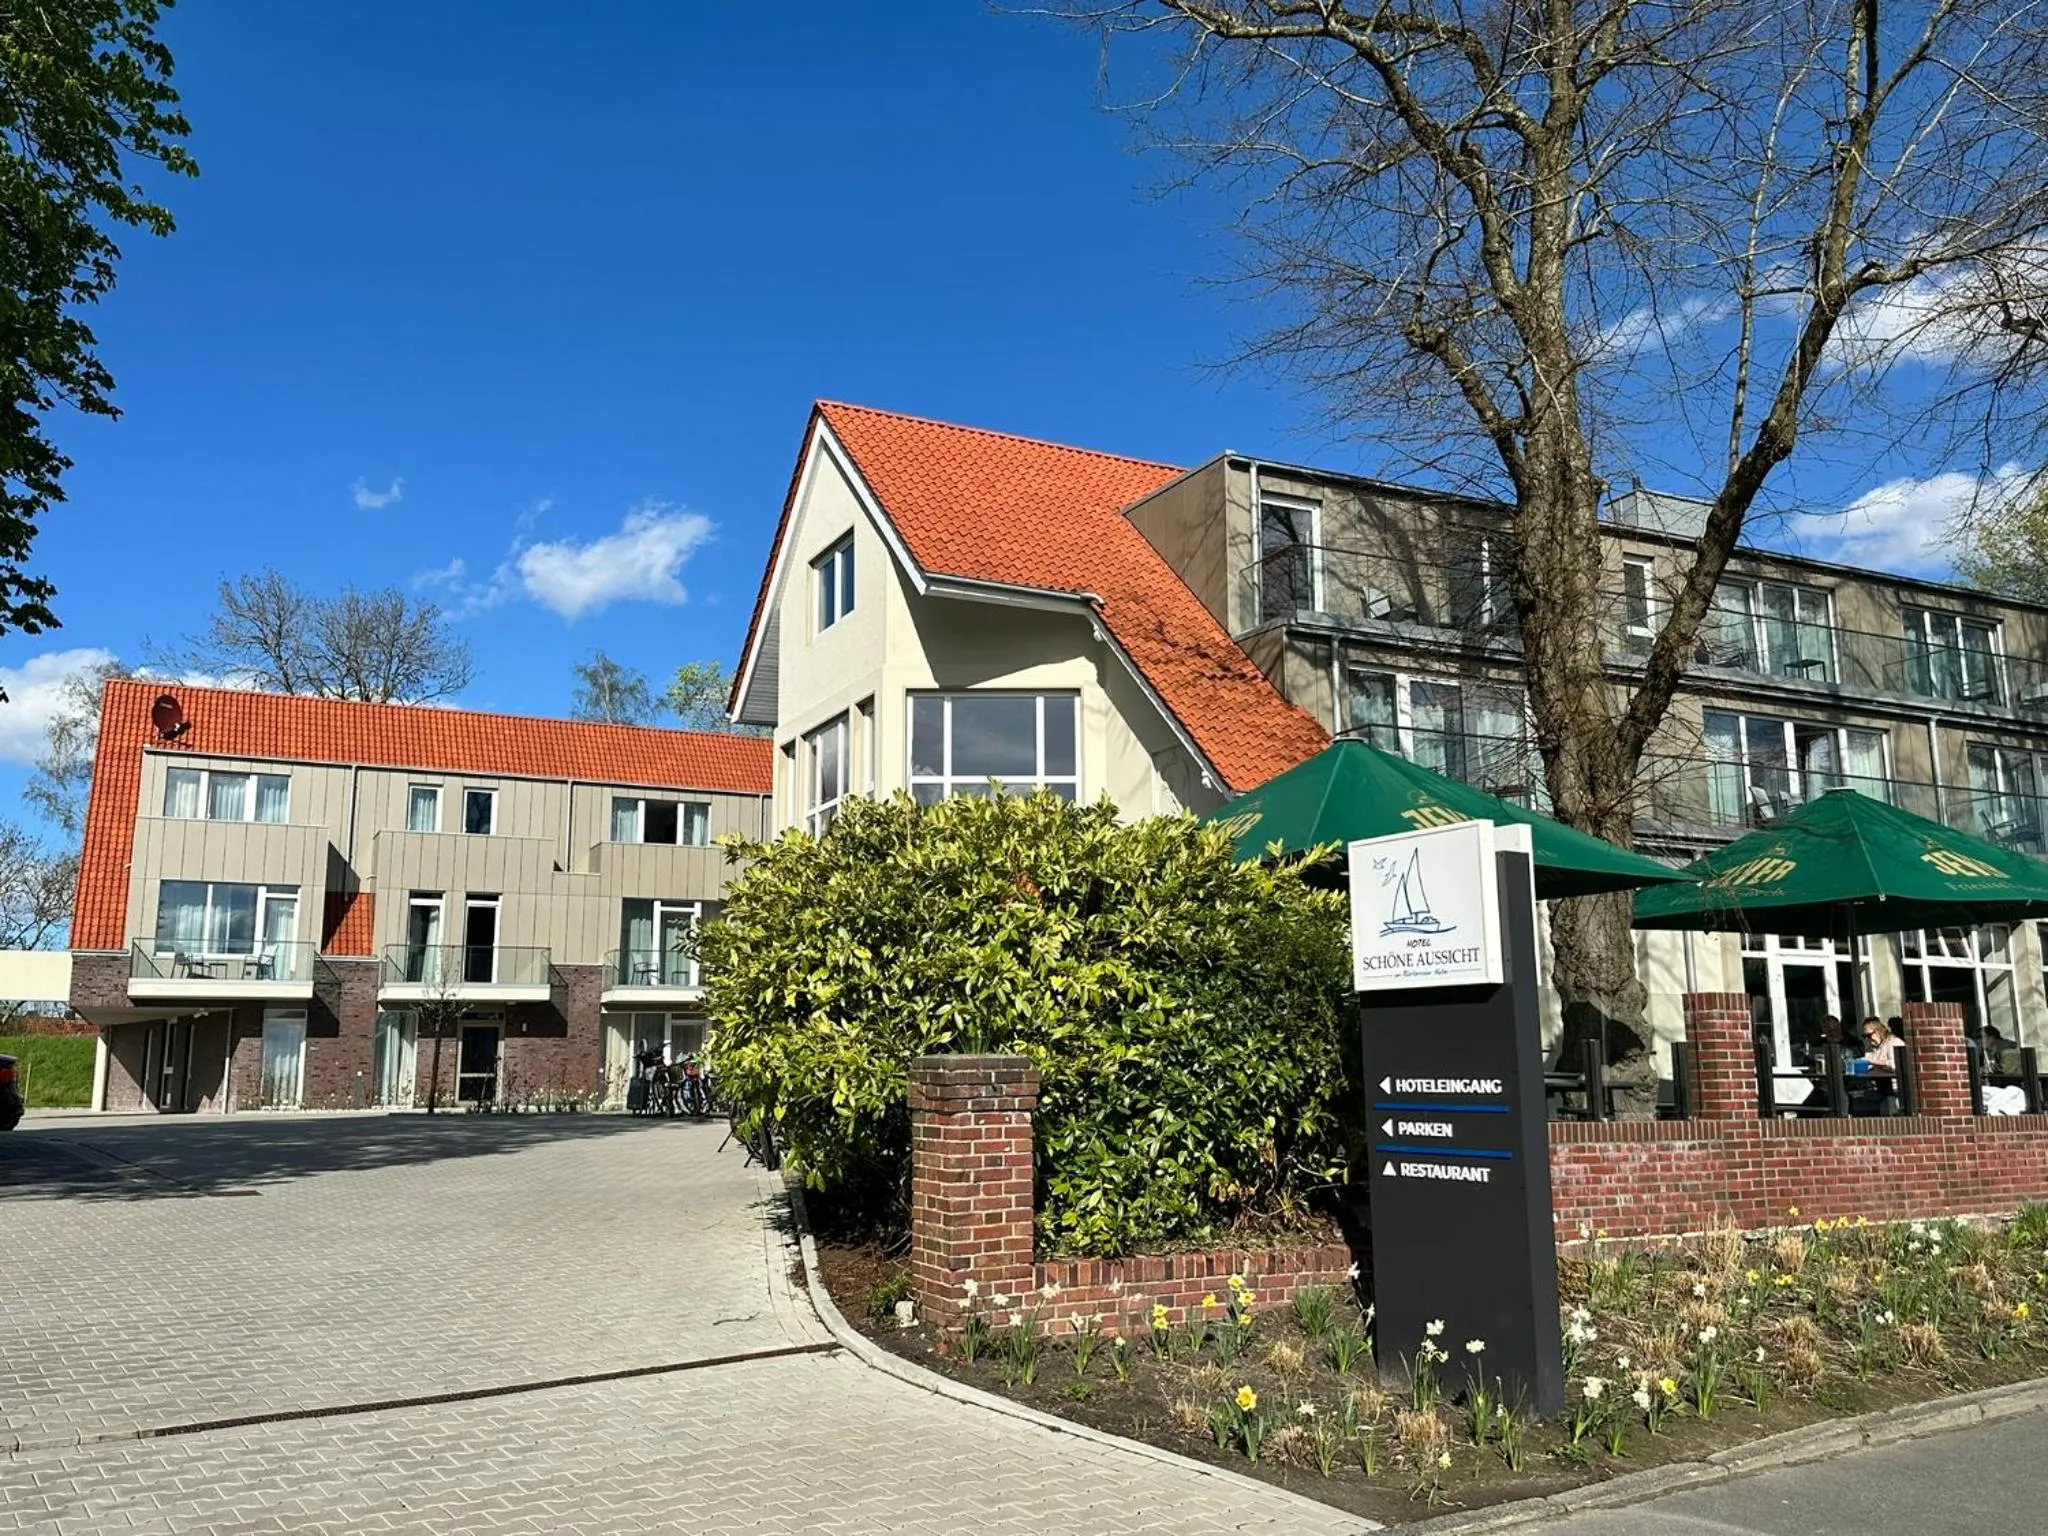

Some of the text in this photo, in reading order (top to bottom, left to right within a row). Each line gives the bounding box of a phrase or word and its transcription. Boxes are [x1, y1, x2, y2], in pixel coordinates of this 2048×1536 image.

[1406, 938, 1432, 948] HOTEL
[1362, 947, 1480, 971] SCHÖNE AUSSICHT
[1395, 1078, 1502, 1094] HOTELEINGANG
[1398, 1121, 1453, 1138] PARKEN
[1400, 1162, 1490, 1183] RESTAURANT
